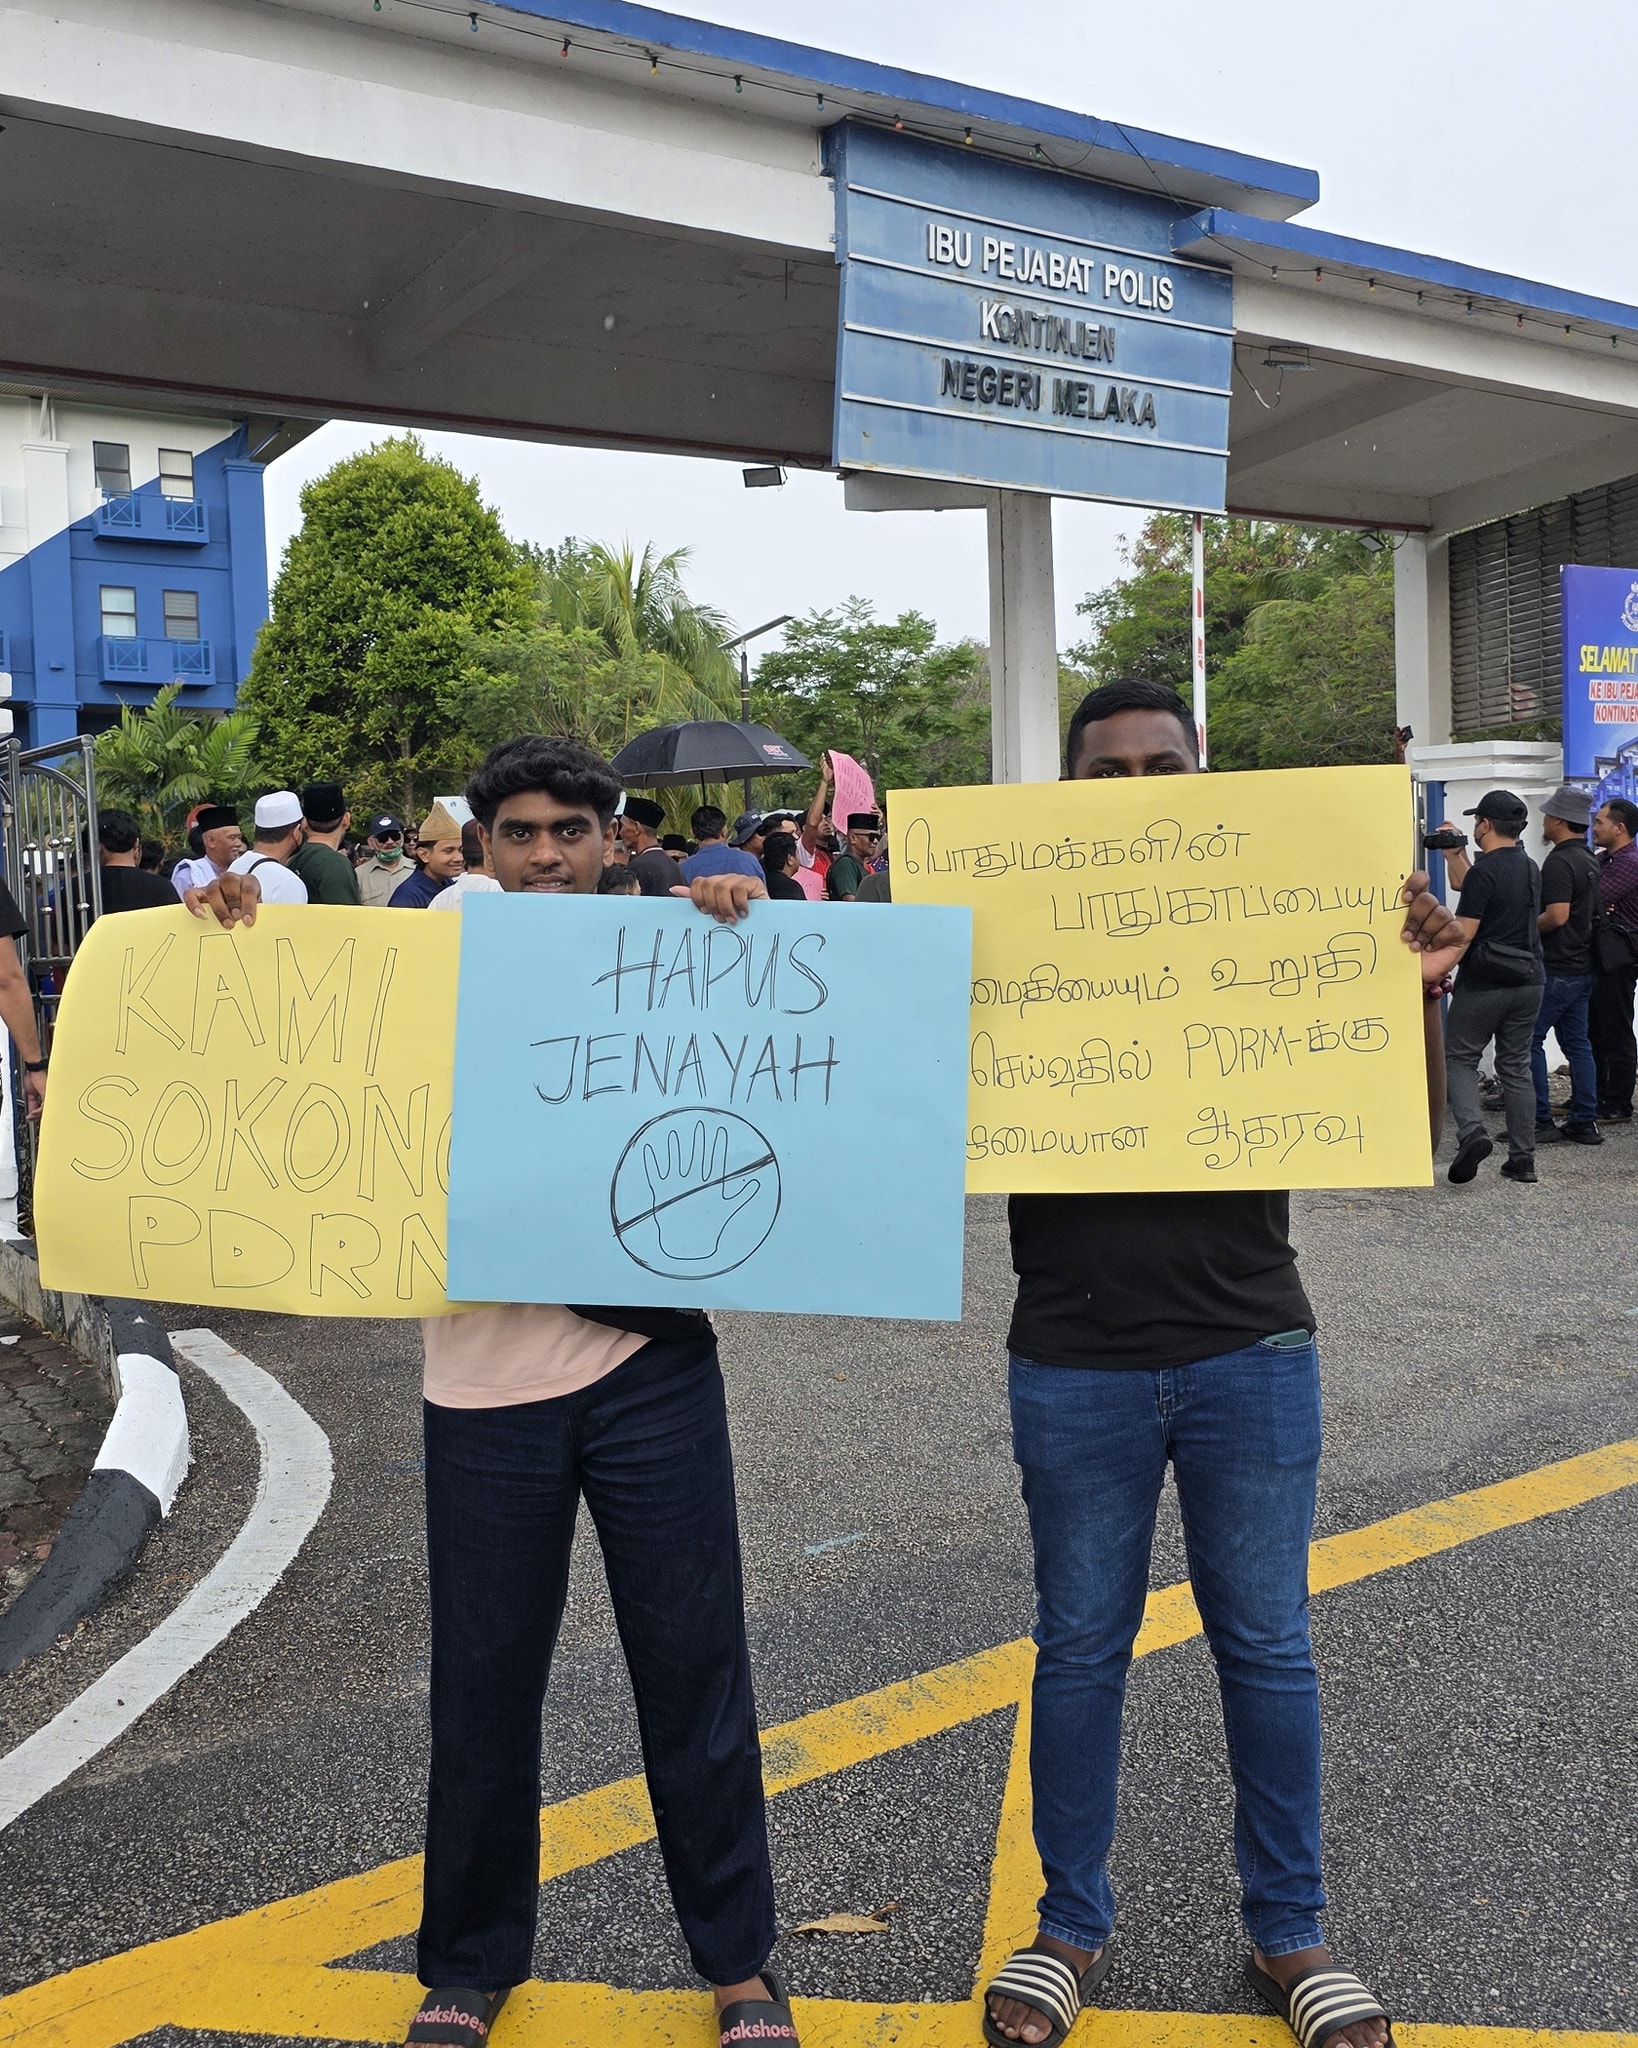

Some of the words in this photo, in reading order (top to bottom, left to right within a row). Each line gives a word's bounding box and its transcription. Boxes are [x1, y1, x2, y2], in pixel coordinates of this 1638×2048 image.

[926, 223, 972, 268] IBU
[981, 235, 1095, 294] PEJABAT
[1103, 263, 1175, 311] POLIS
[980, 299, 1116, 363] KONTINJEN
[940, 357, 1041, 410] NEGERI
[1051, 377, 1157, 429] MELAKA
[1579, 644, 1638, 673] SELAMAT
[1590, 681, 1602, 699] KE
[1604, 682, 1618, 699] IBU
[115, 932, 398, 1076] KAMI
[592, 926, 829, 1015] HAPUS
[530, 1032, 840, 1105] JENAYAH
[70, 1074, 453, 1202] SOKON
